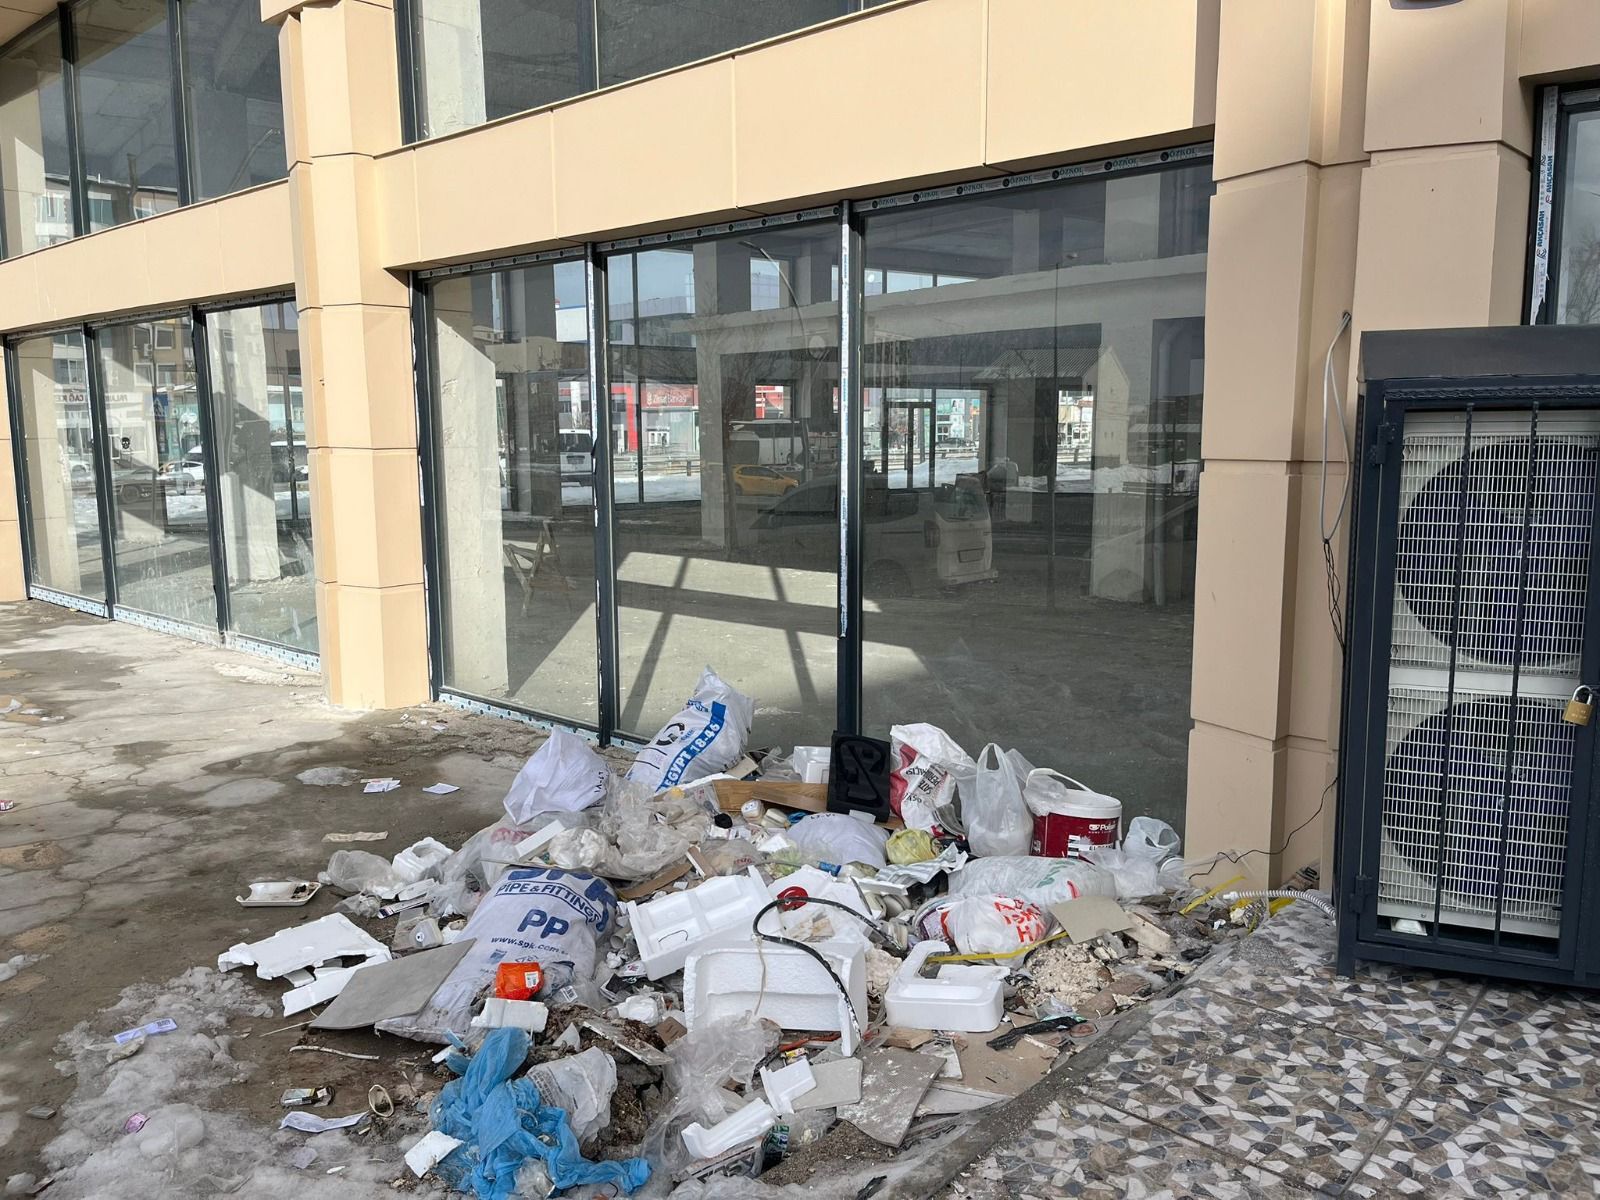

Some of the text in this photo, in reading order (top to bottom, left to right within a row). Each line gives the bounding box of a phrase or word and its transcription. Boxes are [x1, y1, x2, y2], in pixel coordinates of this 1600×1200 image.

[663, 748, 692, 788] EGYPT
[690, 723, 720, 752] 18-46
[497, 883, 602, 924] PIPE & FITTINGS
[517, 909, 569, 939] PP
